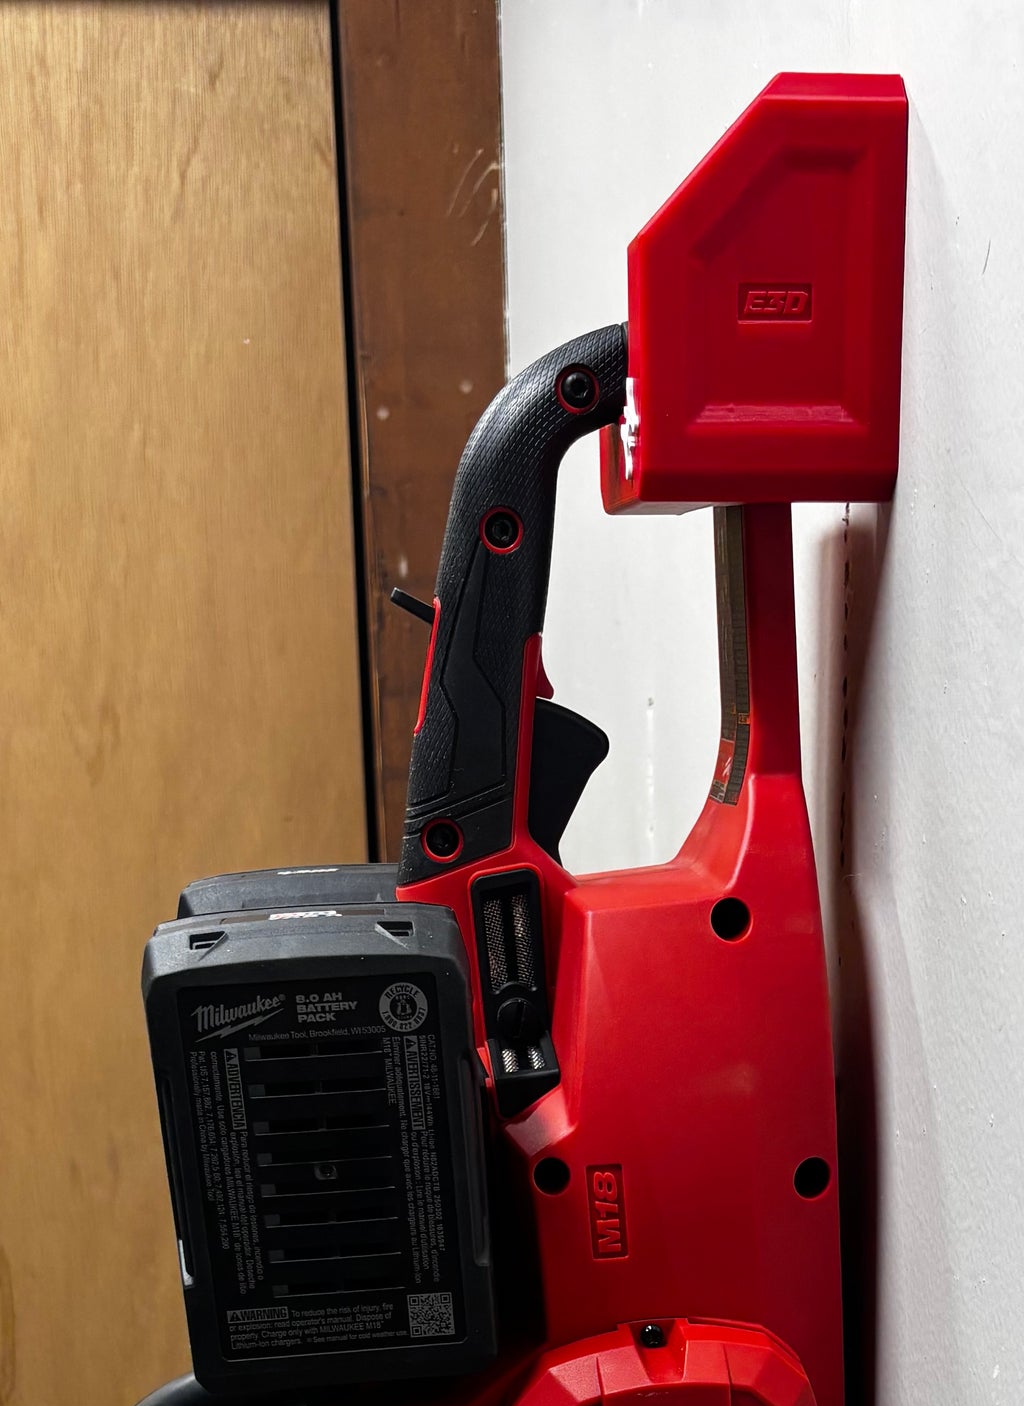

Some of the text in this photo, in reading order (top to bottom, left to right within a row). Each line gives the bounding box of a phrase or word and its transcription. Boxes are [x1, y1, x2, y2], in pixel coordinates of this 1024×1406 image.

[295, 991, 343, 1004] 8.0 AH
[382, 982, 421, 1000] RECYCLE
[296, 1001, 358, 1013] BATTERY
[297, 1012, 336, 1023] PACK
[248, 1032, 290, 1041] Milwaukee
[309, 1028, 350, 1038] Brookfield,
[350, 1026, 362, 1035] WI
[361, 1024, 387, 1034] 53005
[225, 1062, 246, 1128] ADVERTENCIA
[405, 1049, 424, 1128] AVERTISSEMENT
[195, 1097, 204, 1116] made
[216, 1104, 225, 1120] Use
[399, 1119, 408, 1130] Ne
[198, 1124, 207, 1144] China
[239, 1131, 249, 1149] Para
[410, 1131, 418, 1141] ou
[420, 1130, 429, 1148] Pour
[400, 1131, 410, 1158] charger
[220, 1136, 232, 1176] cargadores
[241, 1149, 251, 1173] reducir
[421, 1148, 431, 1173] réduire
[202, 1153, 213, 1187] Milwaukee
[234, 1167, 242, 1179] lea
[402, 1158, 411, 1173] que
[235, 1179, 245, 1187] el
[244, 1174, 254, 1182] el
[404, 1173, 413, 1190] avec
[226, 1176, 239, 1221] MILWAUKEE
[237, 1187, 248, 1214] manual
[245, 1182, 255, 1204] riesgo
[406, 1190, 415, 1202] les
[415, 1185, 424, 1199] Lire
[424, 1181, 433, 1203] risque
[248, 1204, 257, 1214] de
[416, 1199, 425, 1207] le
[426, 1203, 435, 1214] de
[240, 1214, 250, 1226] del
[407, 1202, 417, 1236] chargeurs
[417, 1207, 428, 1233] manuel
[593, 1171, 622, 1253] M18
[233, 1242, 242, 1252] de
[410, 1236, 418, 1246] au
[235, 1252, 244, 1272] iones
[253, 1246, 264, 1275] incendio
[237, 1271, 246, 1282] de
[245, 1259, 256, 1289] Deseche
[241, 1306, 286, 1321] WARNING
[290, 1309, 301, 1318] To
[300, 1309, 326, 1317] reduce
[325, 1307, 338, 1315] the
[338, 1306, 352, 1314] risk
[352, 1304, 360, 1314] of
[381, 1302, 394, 1311] fire
[228, 1325, 237, 1333] or
[273, 1320, 291, 1328] read
[355, 1311, 384, 1322] Dispose
[384, 1311, 392, 1320] of
[260, 1330, 288, 1339] Charge
[287, 1327, 304, 1337] only
[303, 1326, 319, 1335] with
[319, 1322, 365, 1333] MILWAUKEE
[312, 1335, 326, 1343] See
[325, 1333, 349, 1342] manual
[357, 1332, 371, 1340] cold
[371, 1330, 396, 1338] weather
